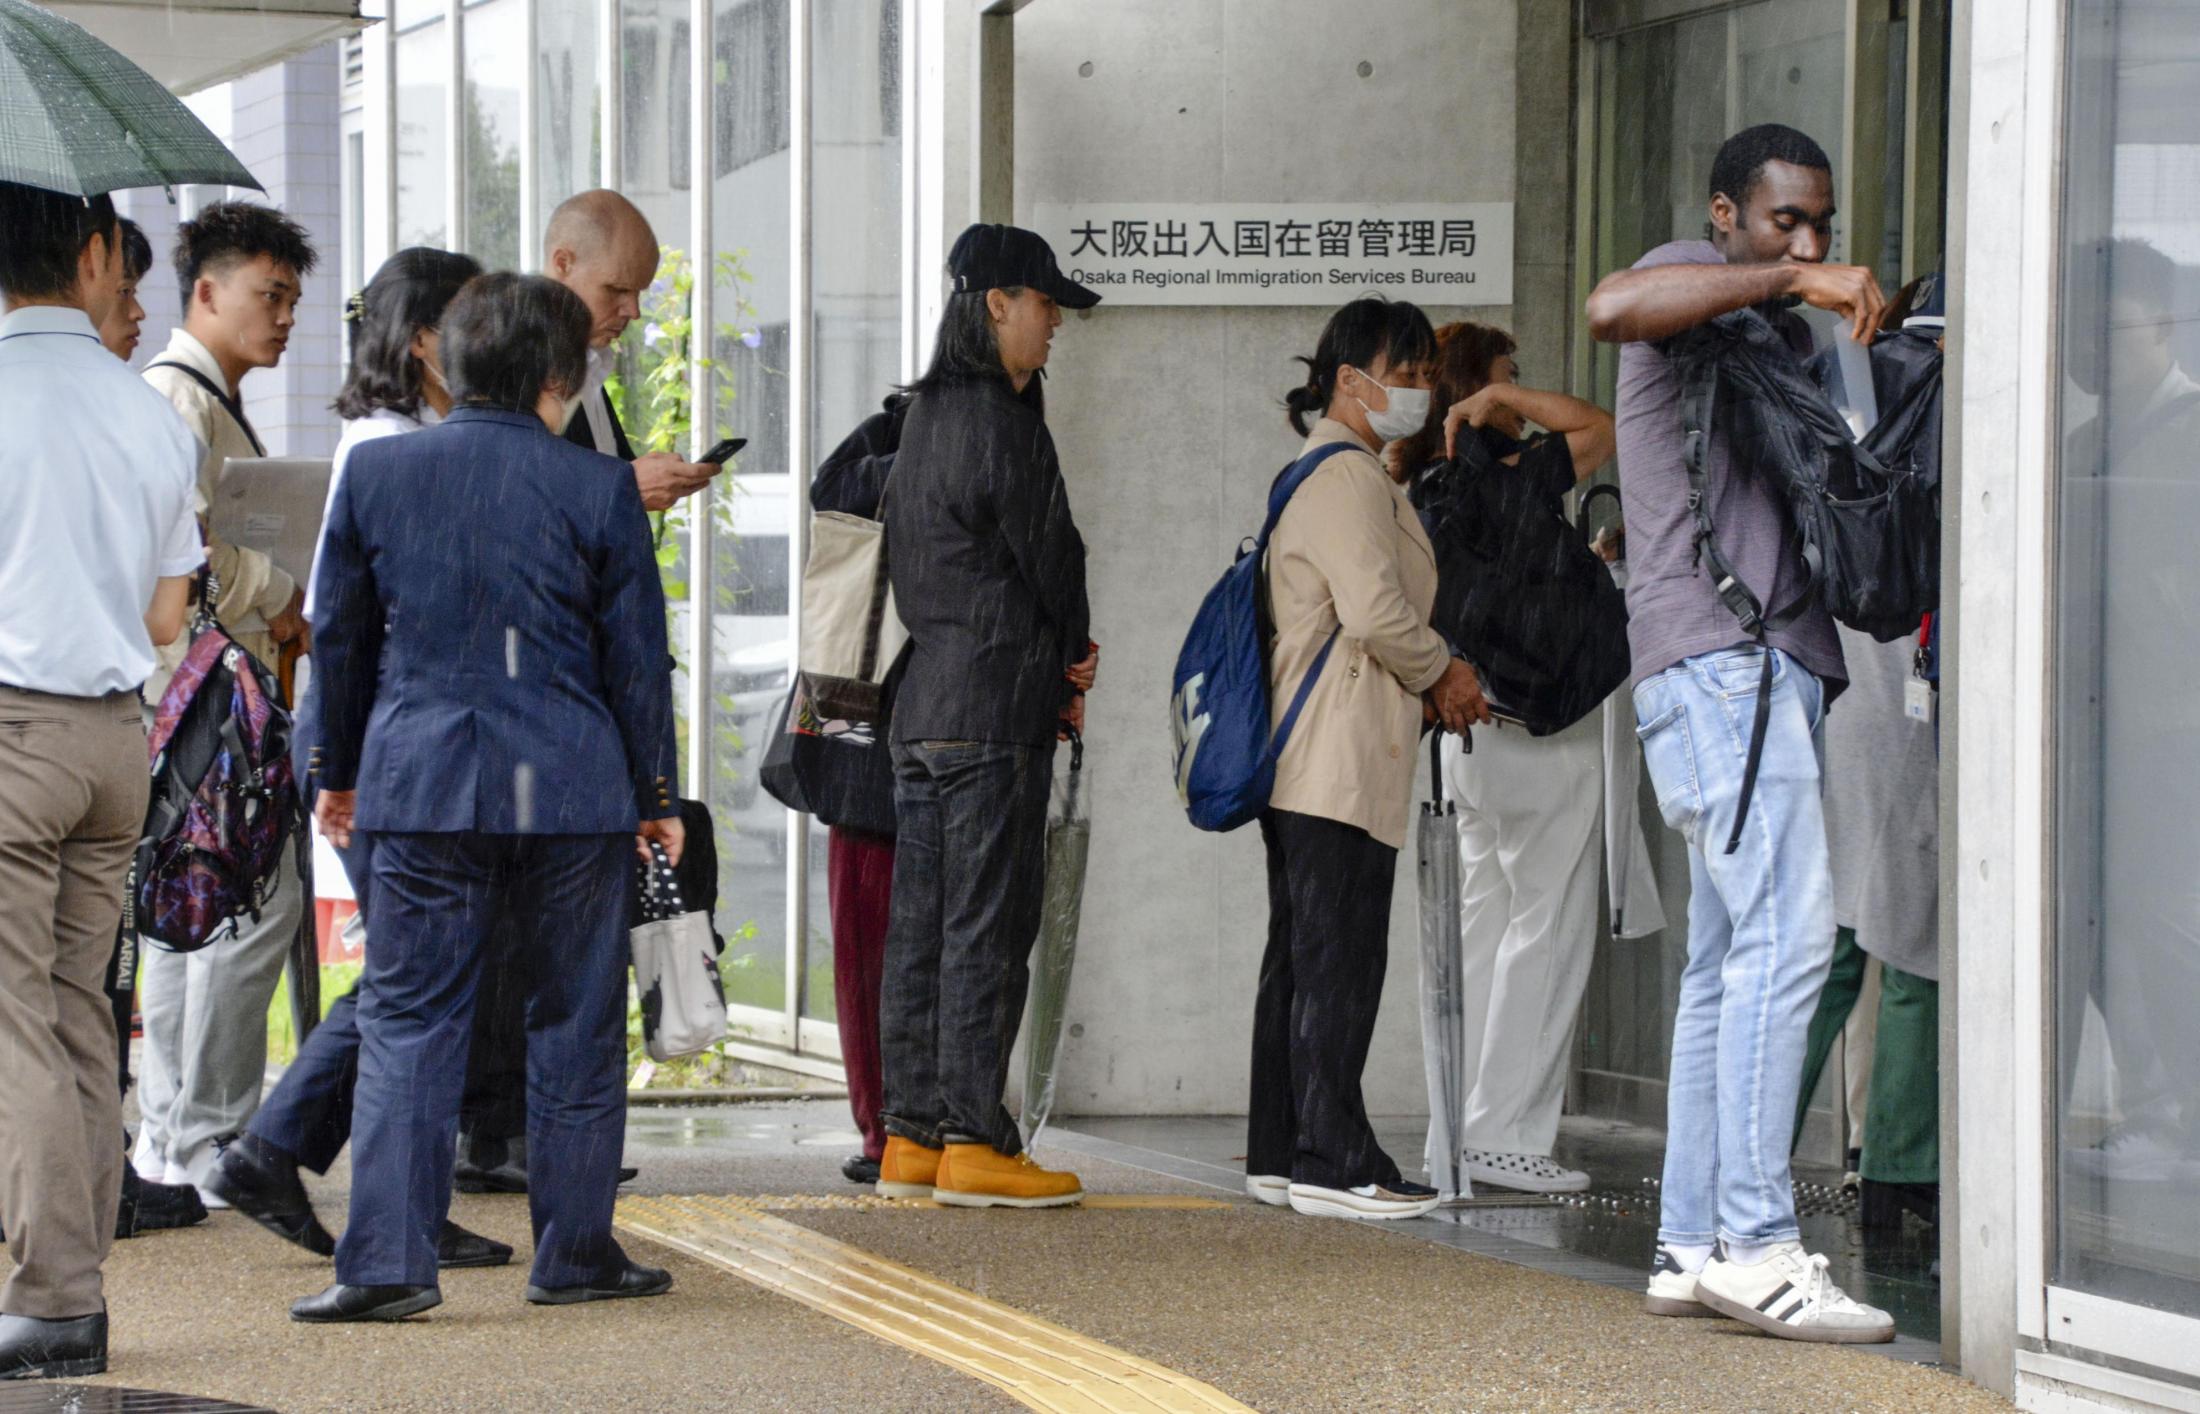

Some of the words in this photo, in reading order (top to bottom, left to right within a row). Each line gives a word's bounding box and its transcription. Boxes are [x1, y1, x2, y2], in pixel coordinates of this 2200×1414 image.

[1070, 219, 1476, 258] 大阪出入国在留管理局
[1070, 268, 1127, 285] Osaka
[1132, 268, 1210, 289] Regional
[1216, 268, 1323, 288] Immigration
[1328, 268, 1405, 285] Services
[1411, 268, 1476, 285] Bureau
